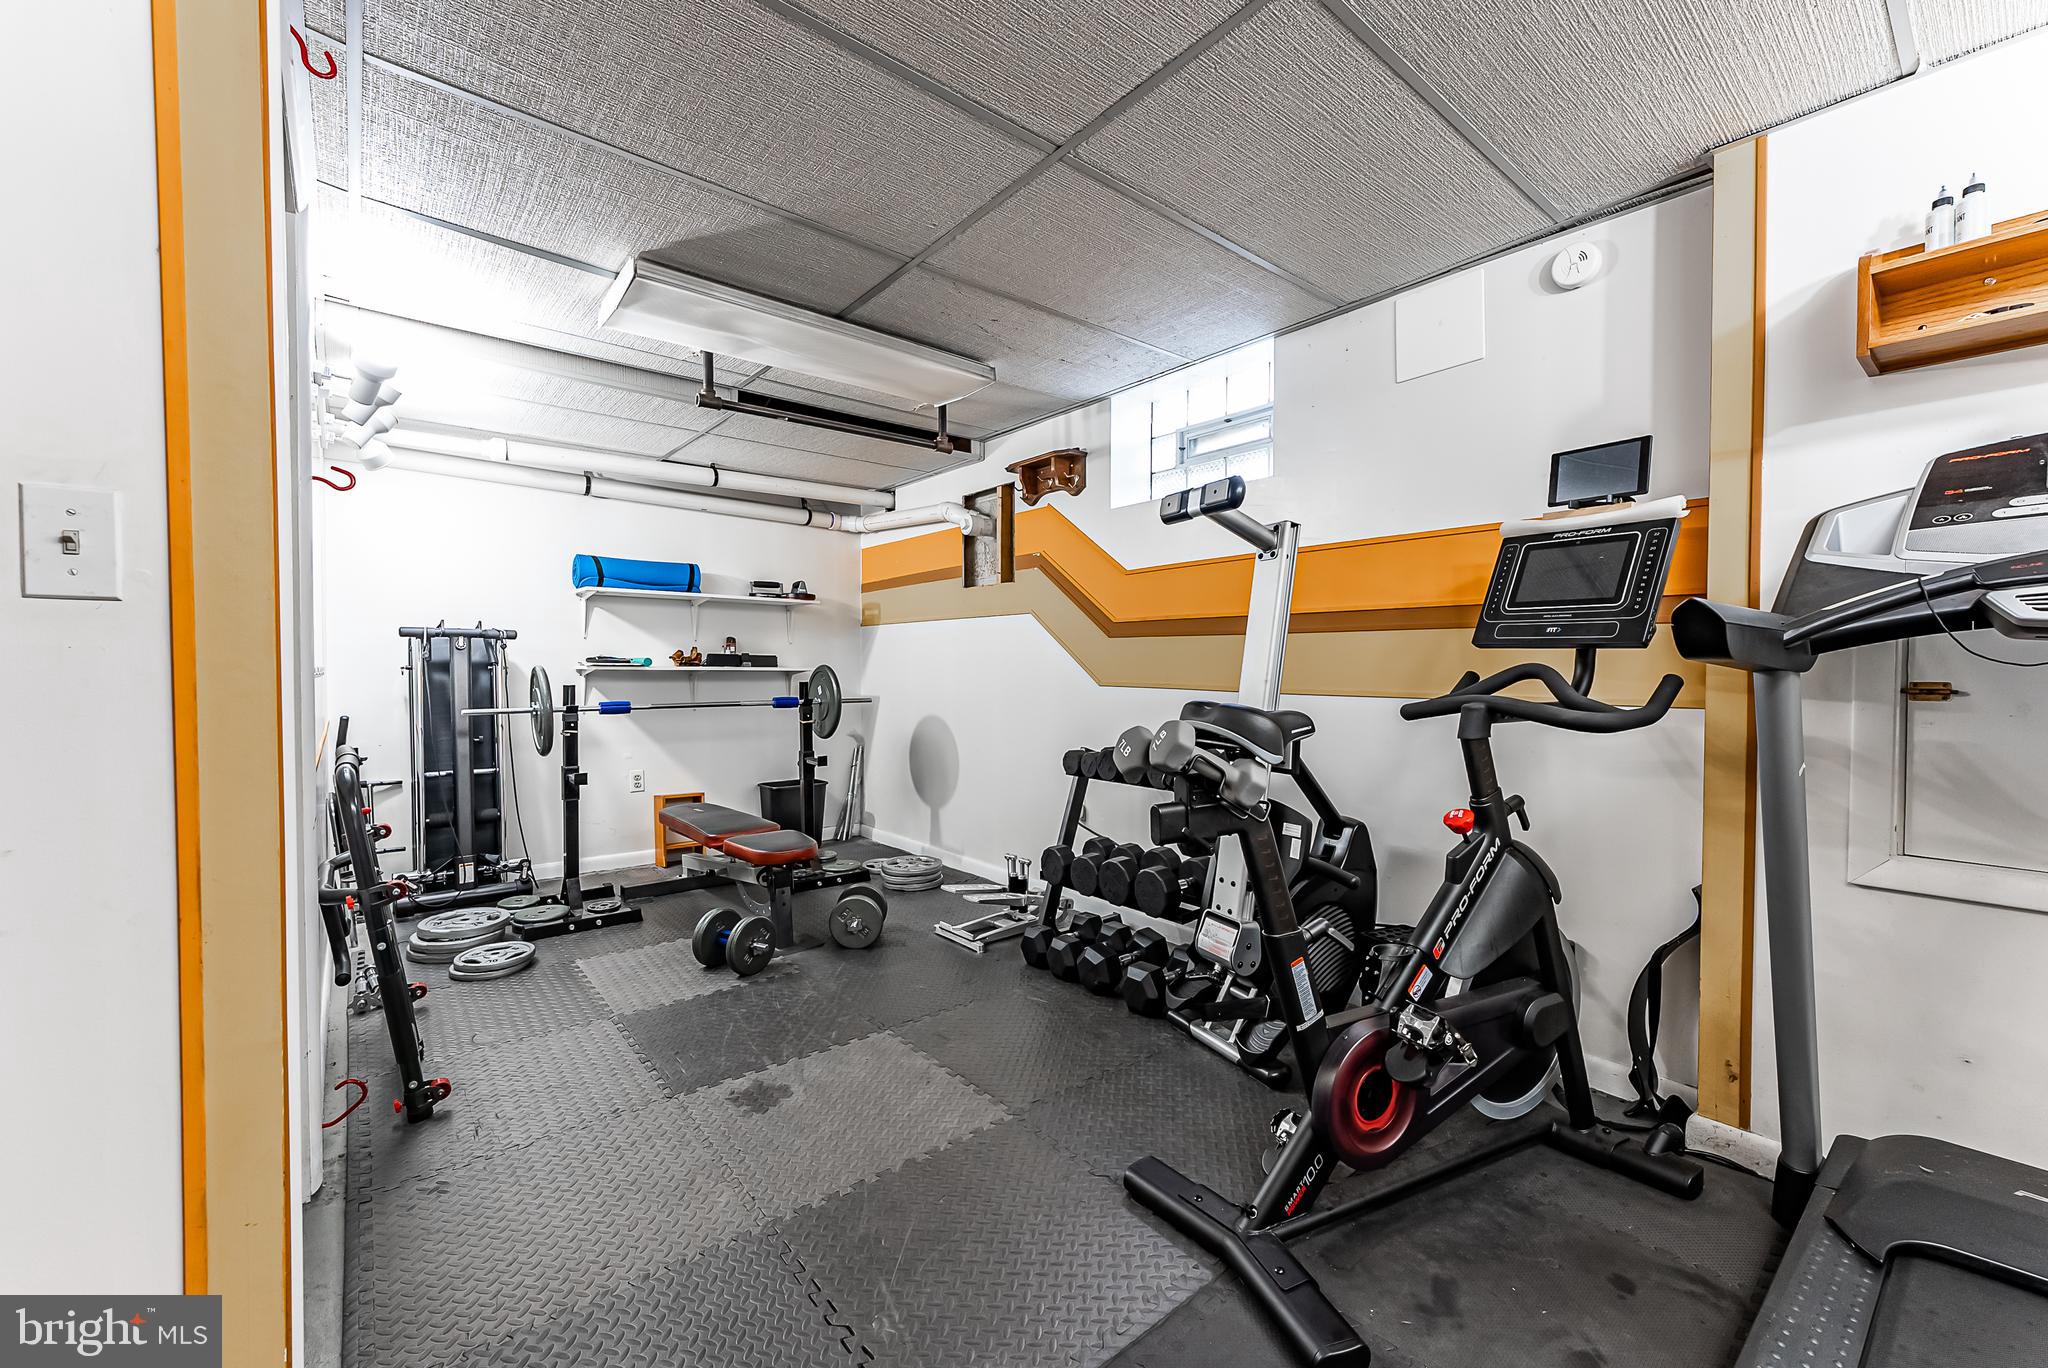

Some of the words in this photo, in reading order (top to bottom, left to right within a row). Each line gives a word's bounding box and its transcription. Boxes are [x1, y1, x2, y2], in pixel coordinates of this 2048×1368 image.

[1552, 527, 1612, 539] PRO-FORM
[1118, 739, 1132, 757] 7LB
[1152, 729, 1167, 751] 7LB
[1443, 837, 1501, 939] PRO-FORM
[1302, 1153, 1324, 1186] 10.0
